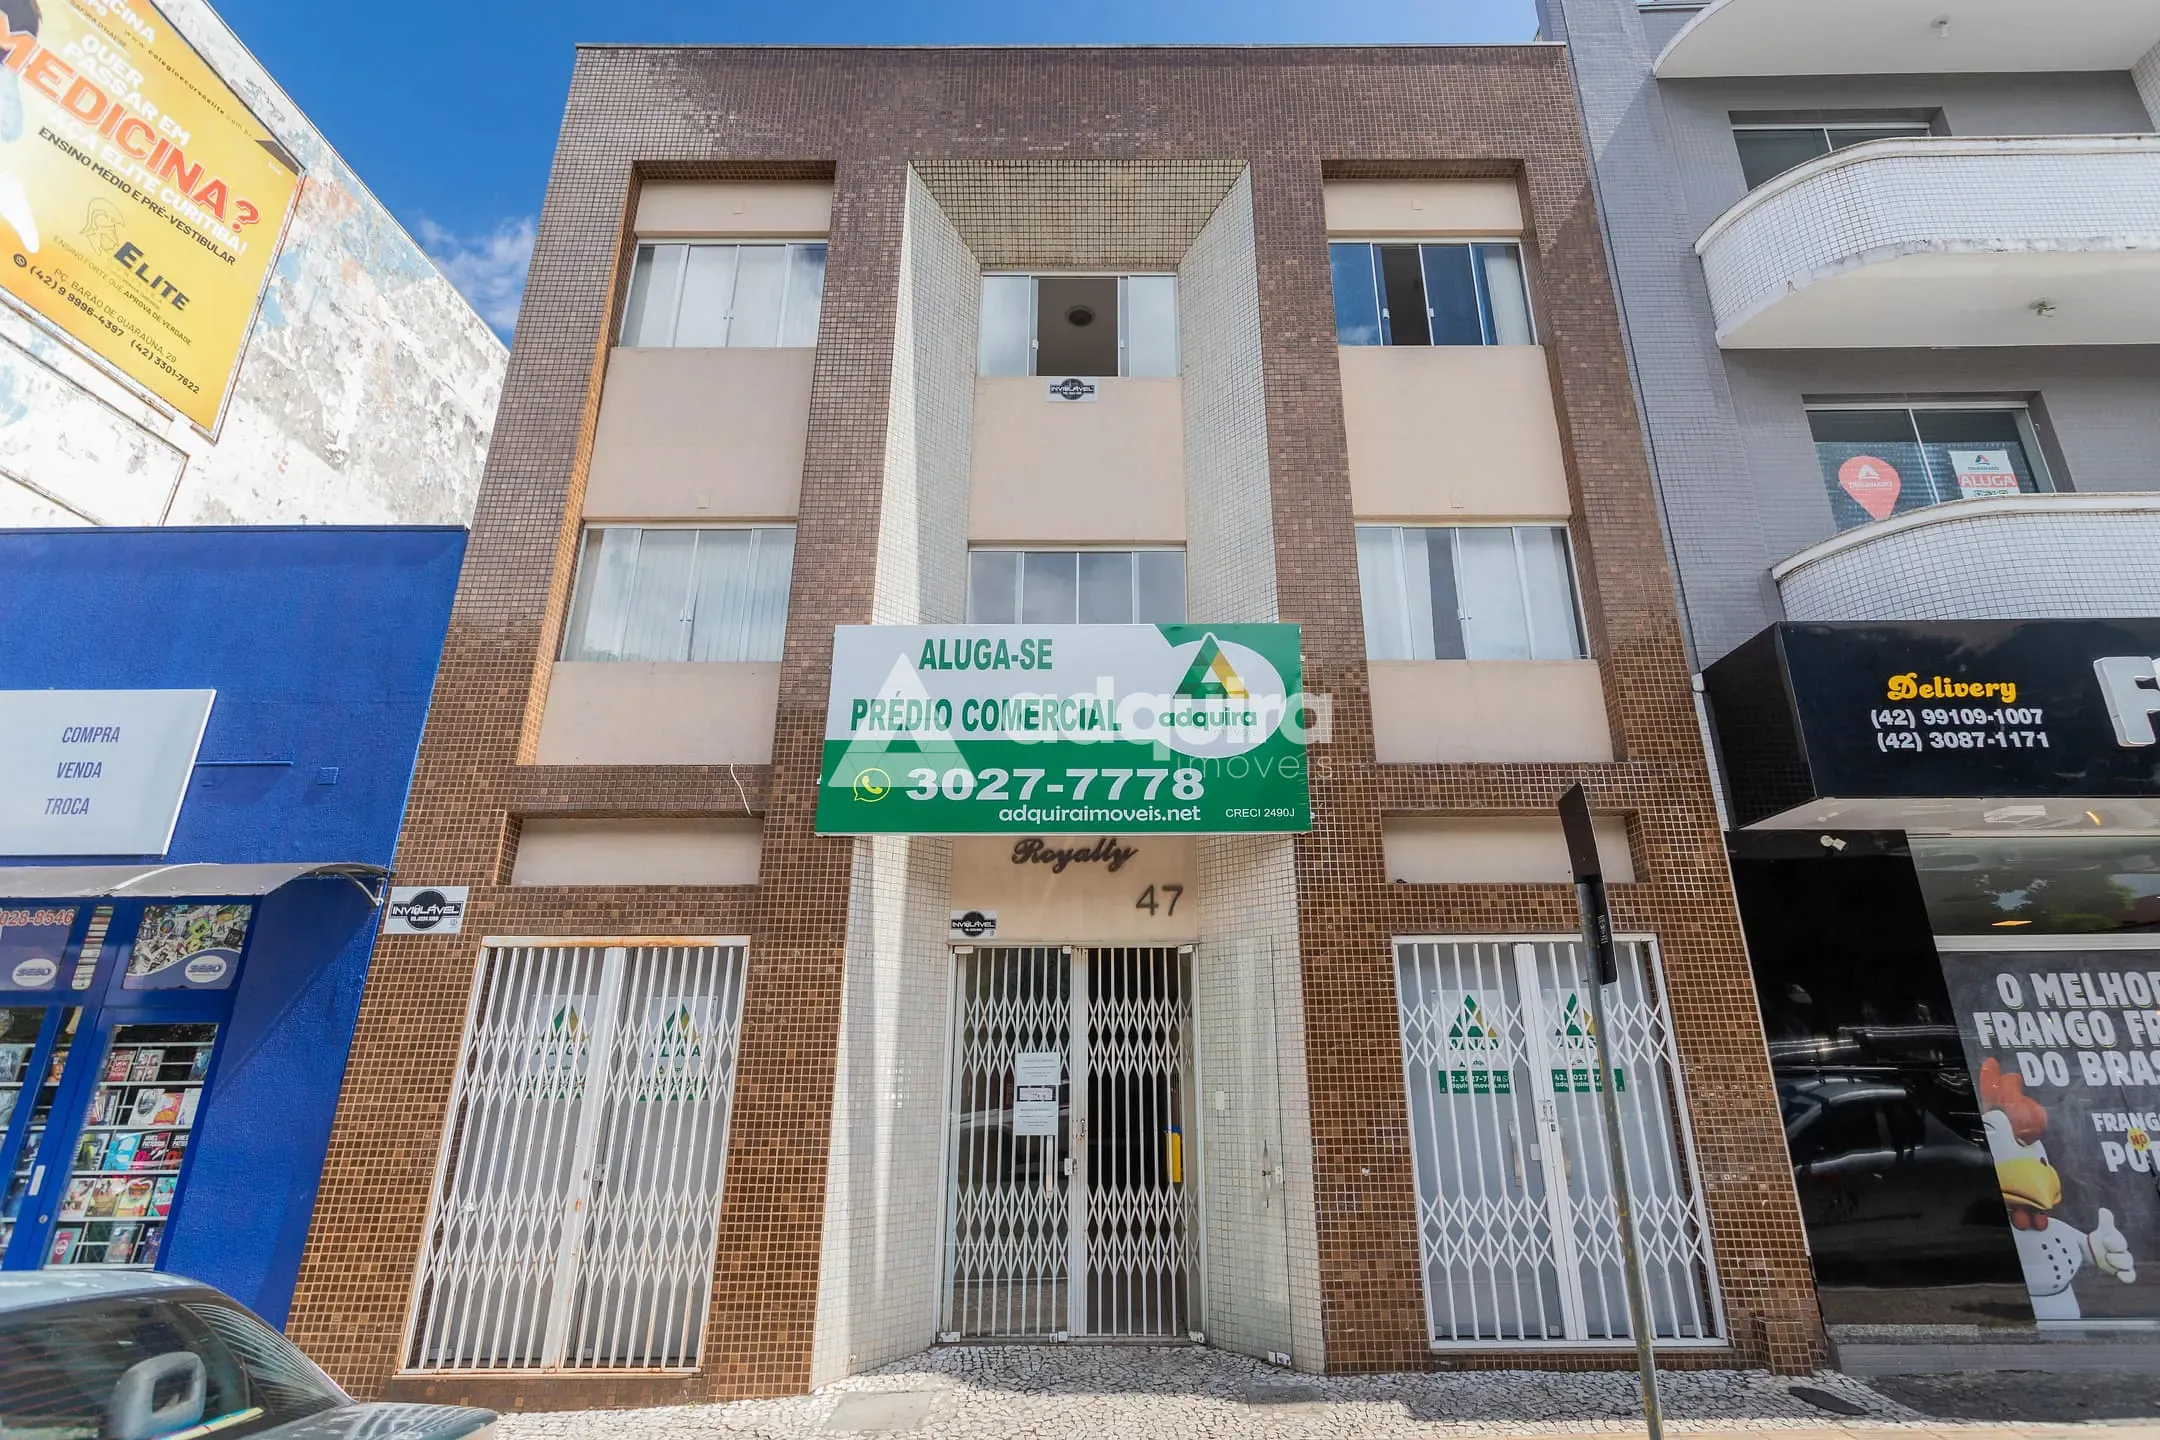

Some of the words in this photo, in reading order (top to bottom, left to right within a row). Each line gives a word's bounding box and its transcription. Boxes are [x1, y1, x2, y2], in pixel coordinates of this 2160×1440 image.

[104, 0, 155, 44] CINA
[81, 33, 144, 88] QUER
[63, 41, 159, 121] PASSAR
[158, 114, 191, 146] EM
[101, 144, 161, 195] ELITE
[38, 126, 91, 167] ENSINO
[91, 162, 132, 194] MÉDIO
[131, 189, 143, 201] E
[140, 195, 236, 266] PRÉ-VESTIBULAR
[114, 241, 191, 312] ELITE
[123, 290, 152, 316] APROVA
[151, 311, 163, 324] DE
[29, 264, 59, 291] (42)
[56, 286, 67, 296] 9
[66, 292, 126, 338] 9996-4397
[129, 338, 155, 361] (42)
[153, 357, 201, 395] 3301-7622
[103, 304, 118, 319] DE
[165, 351, 178, 364] 29
[1961, 475, 2015, 486] ALUGA
[918, 638, 1054, 671] ALUGA-SE
[1887, 672, 2017, 704] Delivery
[850, 690, 953, 731] PRÉDIO
[961, 698, 1122, 731] COMERCIAL
[1158, 706, 1258, 731] adquira
[1870, 708, 1916, 730] (42)
[1922, 708, 2043, 726] 99109-1007
[62, 726, 121, 743] COMPRA
[1877, 732, 1922, 752] (42)
[1929, 731, 2050, 749] 3087-1171
[57, 761, 103, 778] VENDA
[905, 767, 1205, 801] 3027-7778
[44, 798, 90, 815] TROCA
[998, 804, 1202, 825] adquiraimoveis.net
[1225, 808, 1261, 818] CRECI
[1263, 808, 1295, 818] 2490J
[1136, 883, 1184, 917] 47
[1996, 973, 2024, 1009] O
[1973, 1011, 2118, 1048] FRANGO
[2016, 1051, 2070, 1087] DO
[2091, 1112, 2160, 1132] FRANG
